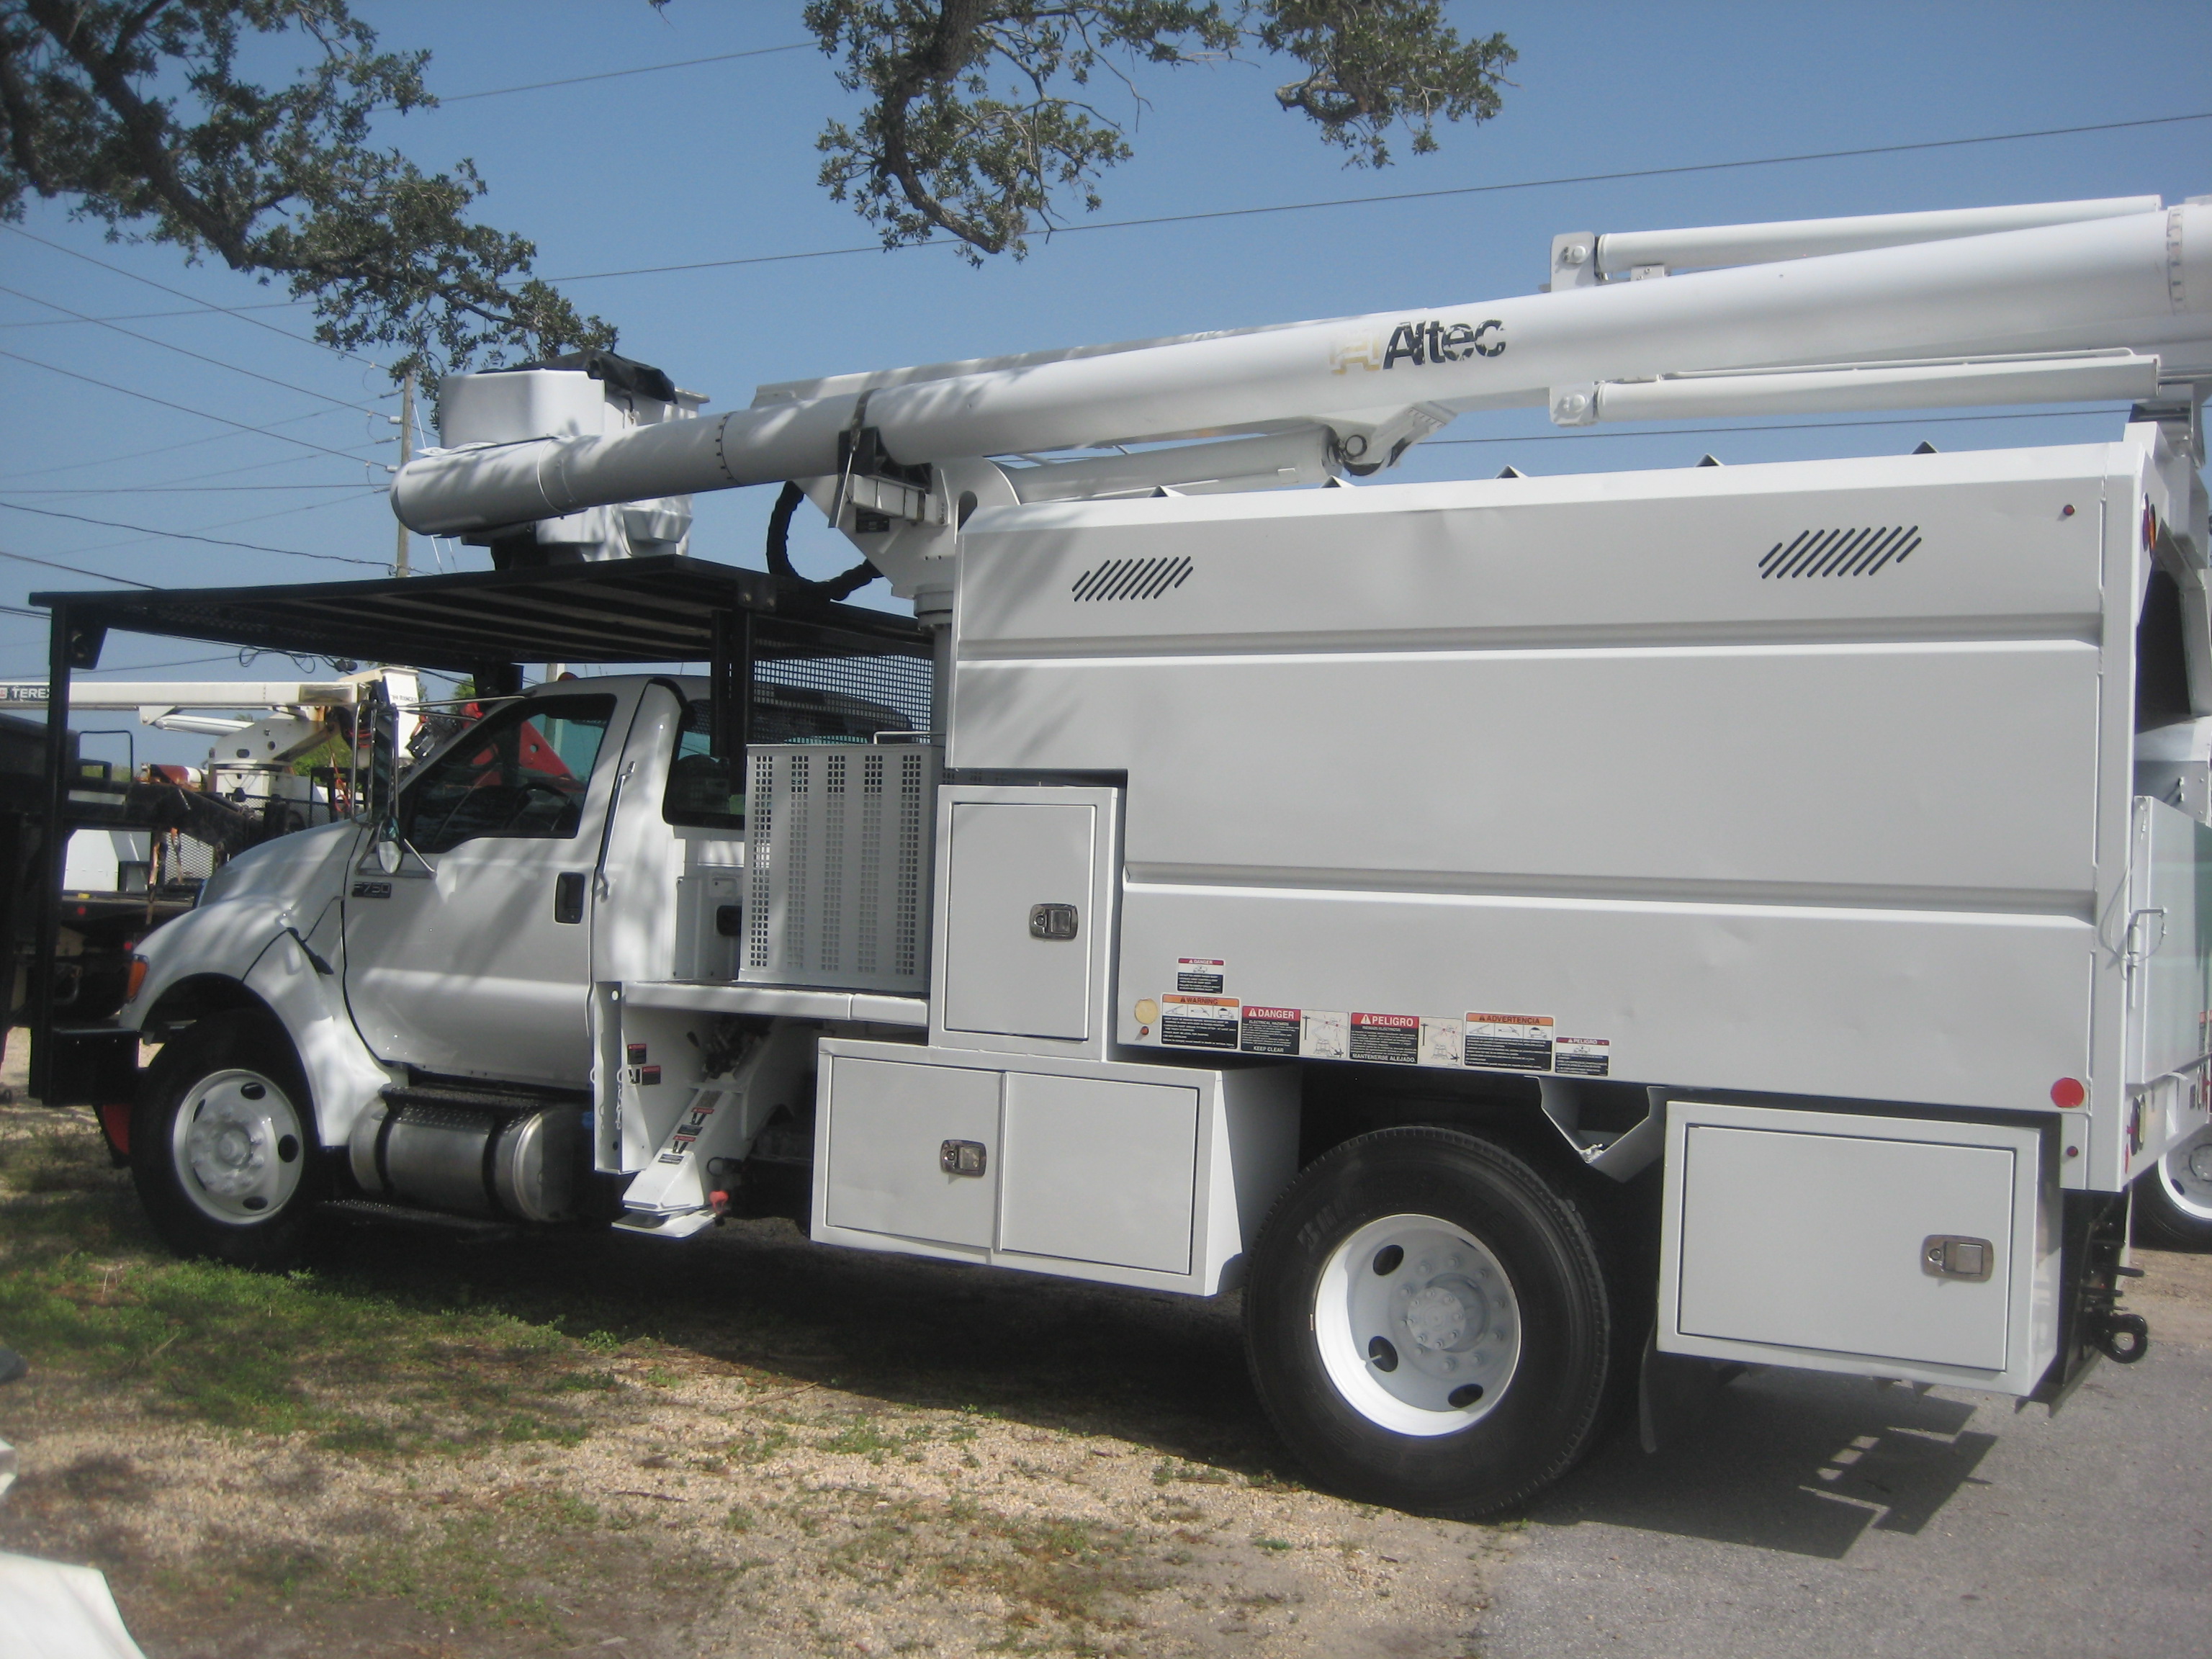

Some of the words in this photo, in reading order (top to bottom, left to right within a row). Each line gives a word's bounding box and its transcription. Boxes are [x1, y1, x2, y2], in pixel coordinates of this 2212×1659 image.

[1382, 318, 1506, 370] Altec
[1258, 1009, 1295, 1019] DANGER
[1486, 1015, 1540, 1024] ADVERTENCIA
[1372, 1015, 1413, 1027] PELIGRO
